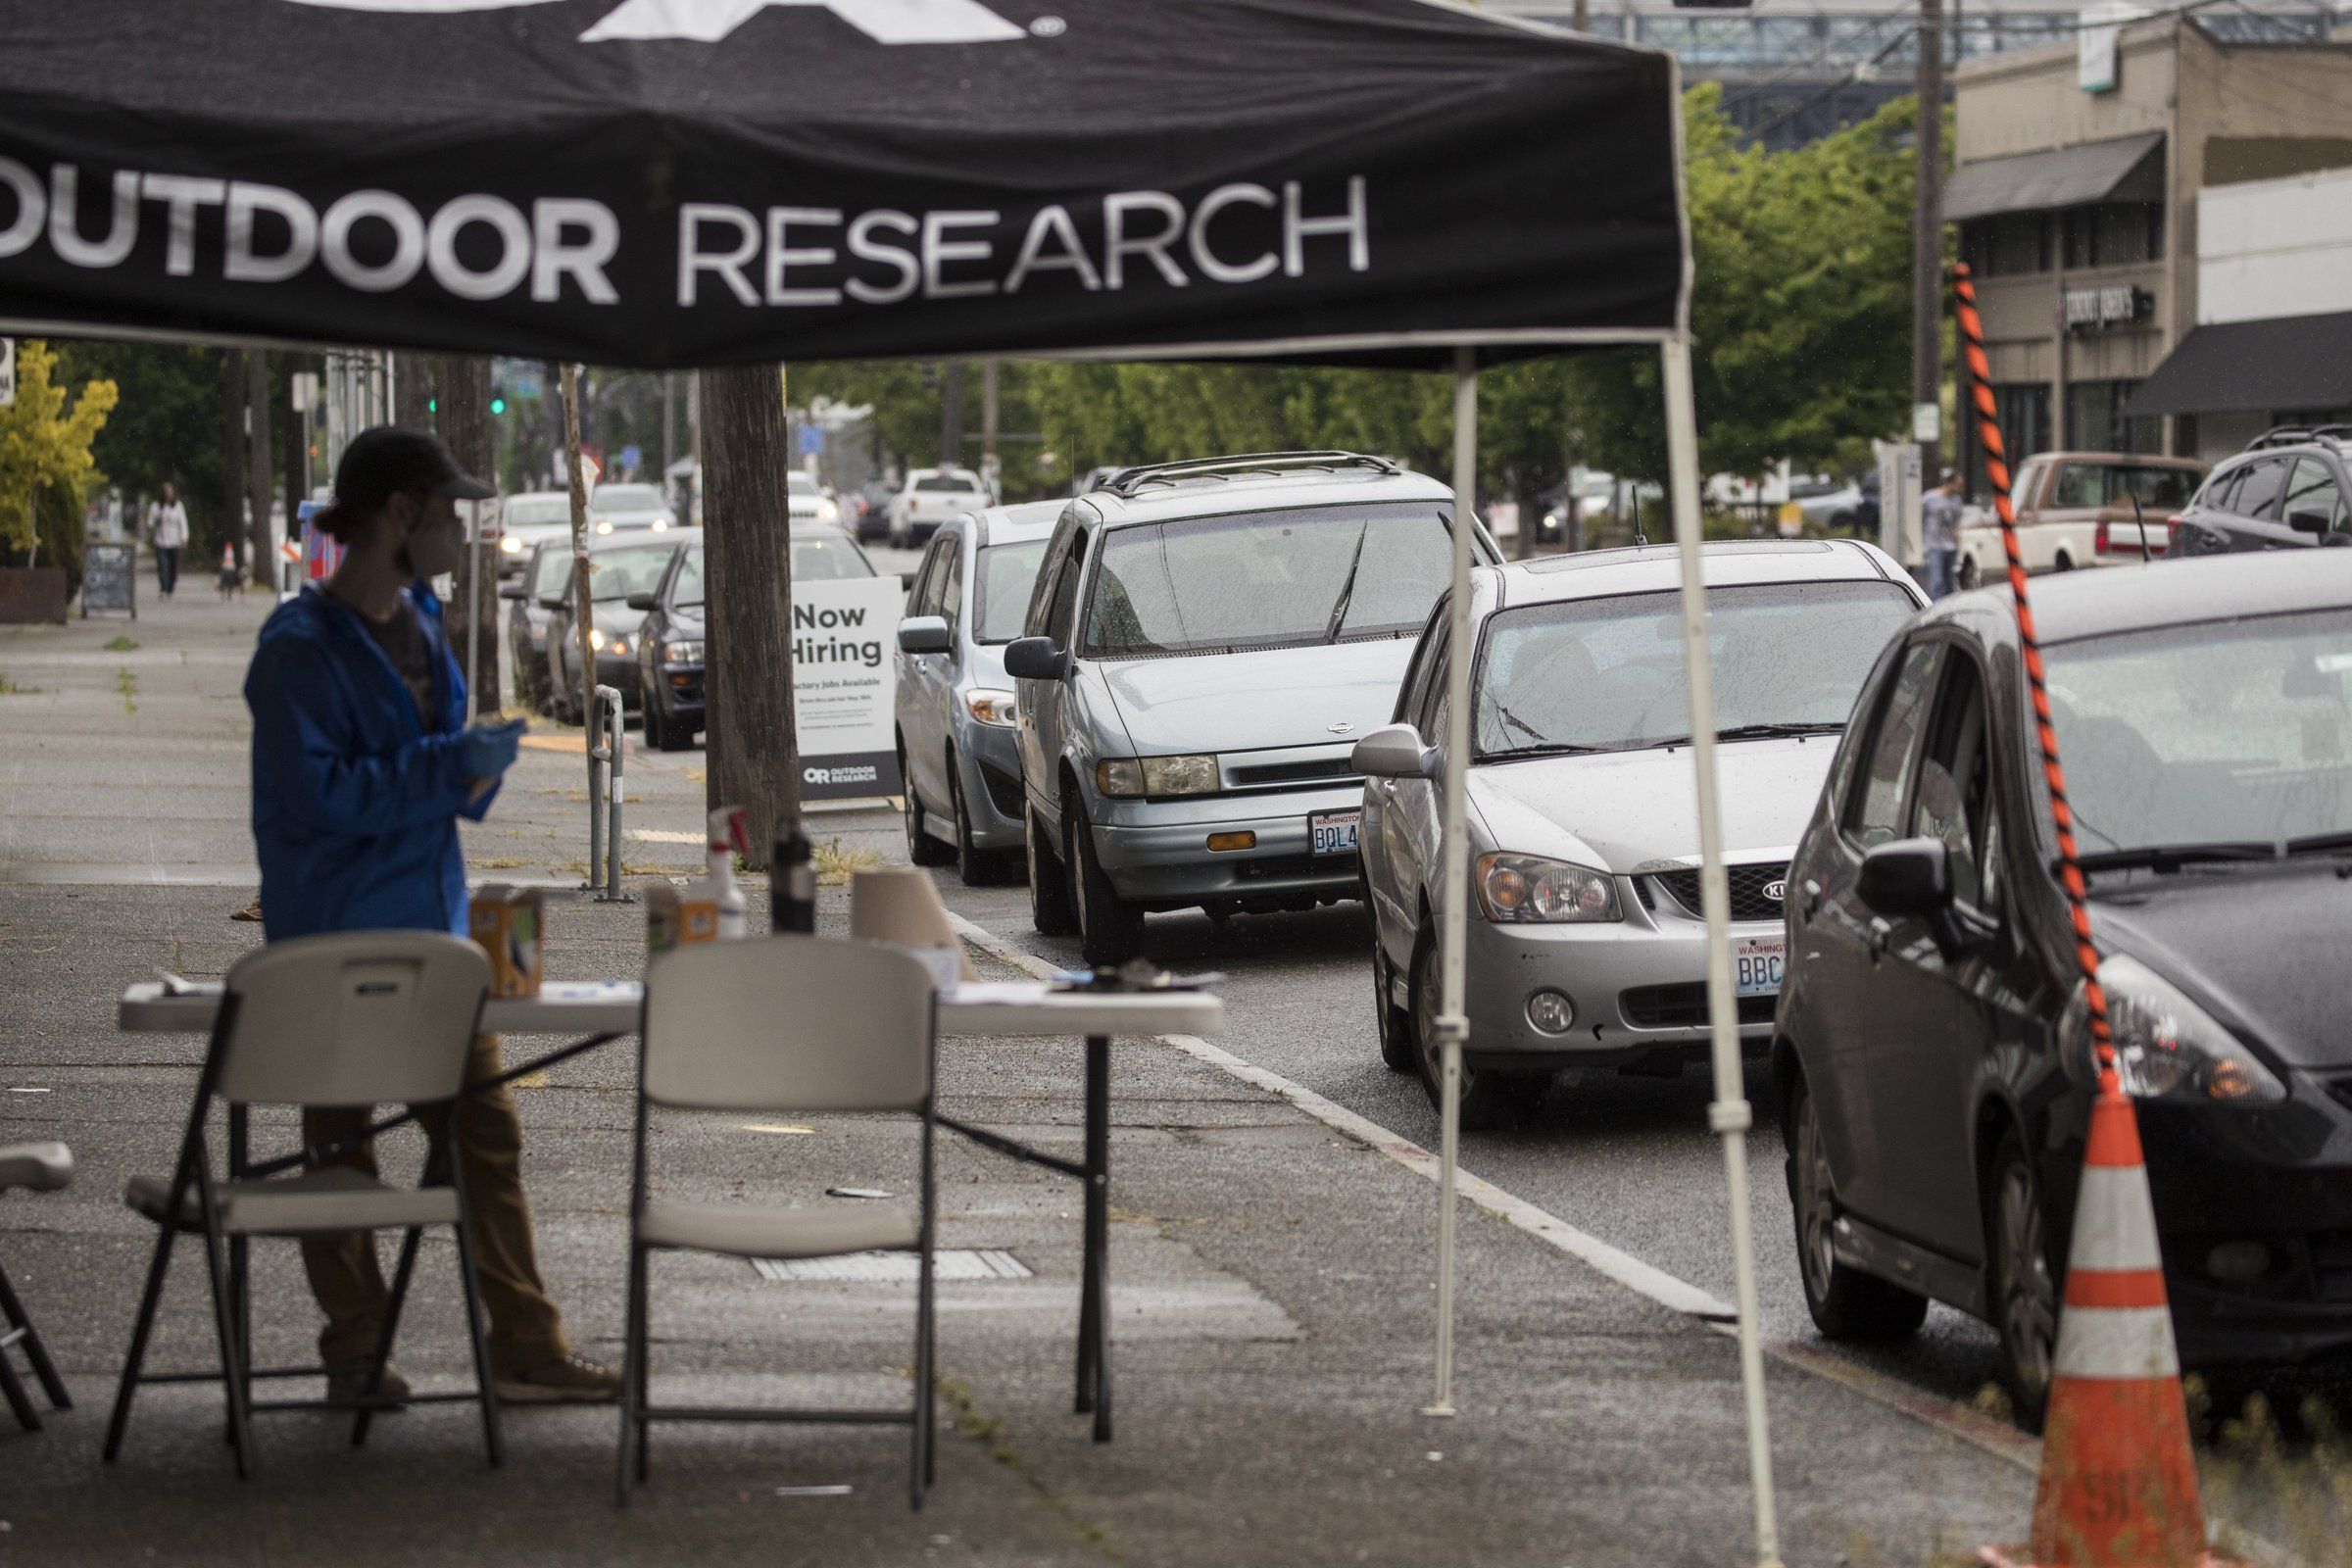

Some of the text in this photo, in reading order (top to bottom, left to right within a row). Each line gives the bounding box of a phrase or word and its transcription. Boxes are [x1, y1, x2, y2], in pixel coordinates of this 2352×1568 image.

[677, 174, 1370, 307] RESEARCH
[794, 603, 866, 629] Now
[792, 676, 880, 691] actory Jobs Available
[804, 765, 876, 784] OR OUTDOOR
[831, 773, 877, 783] RESEARCH
